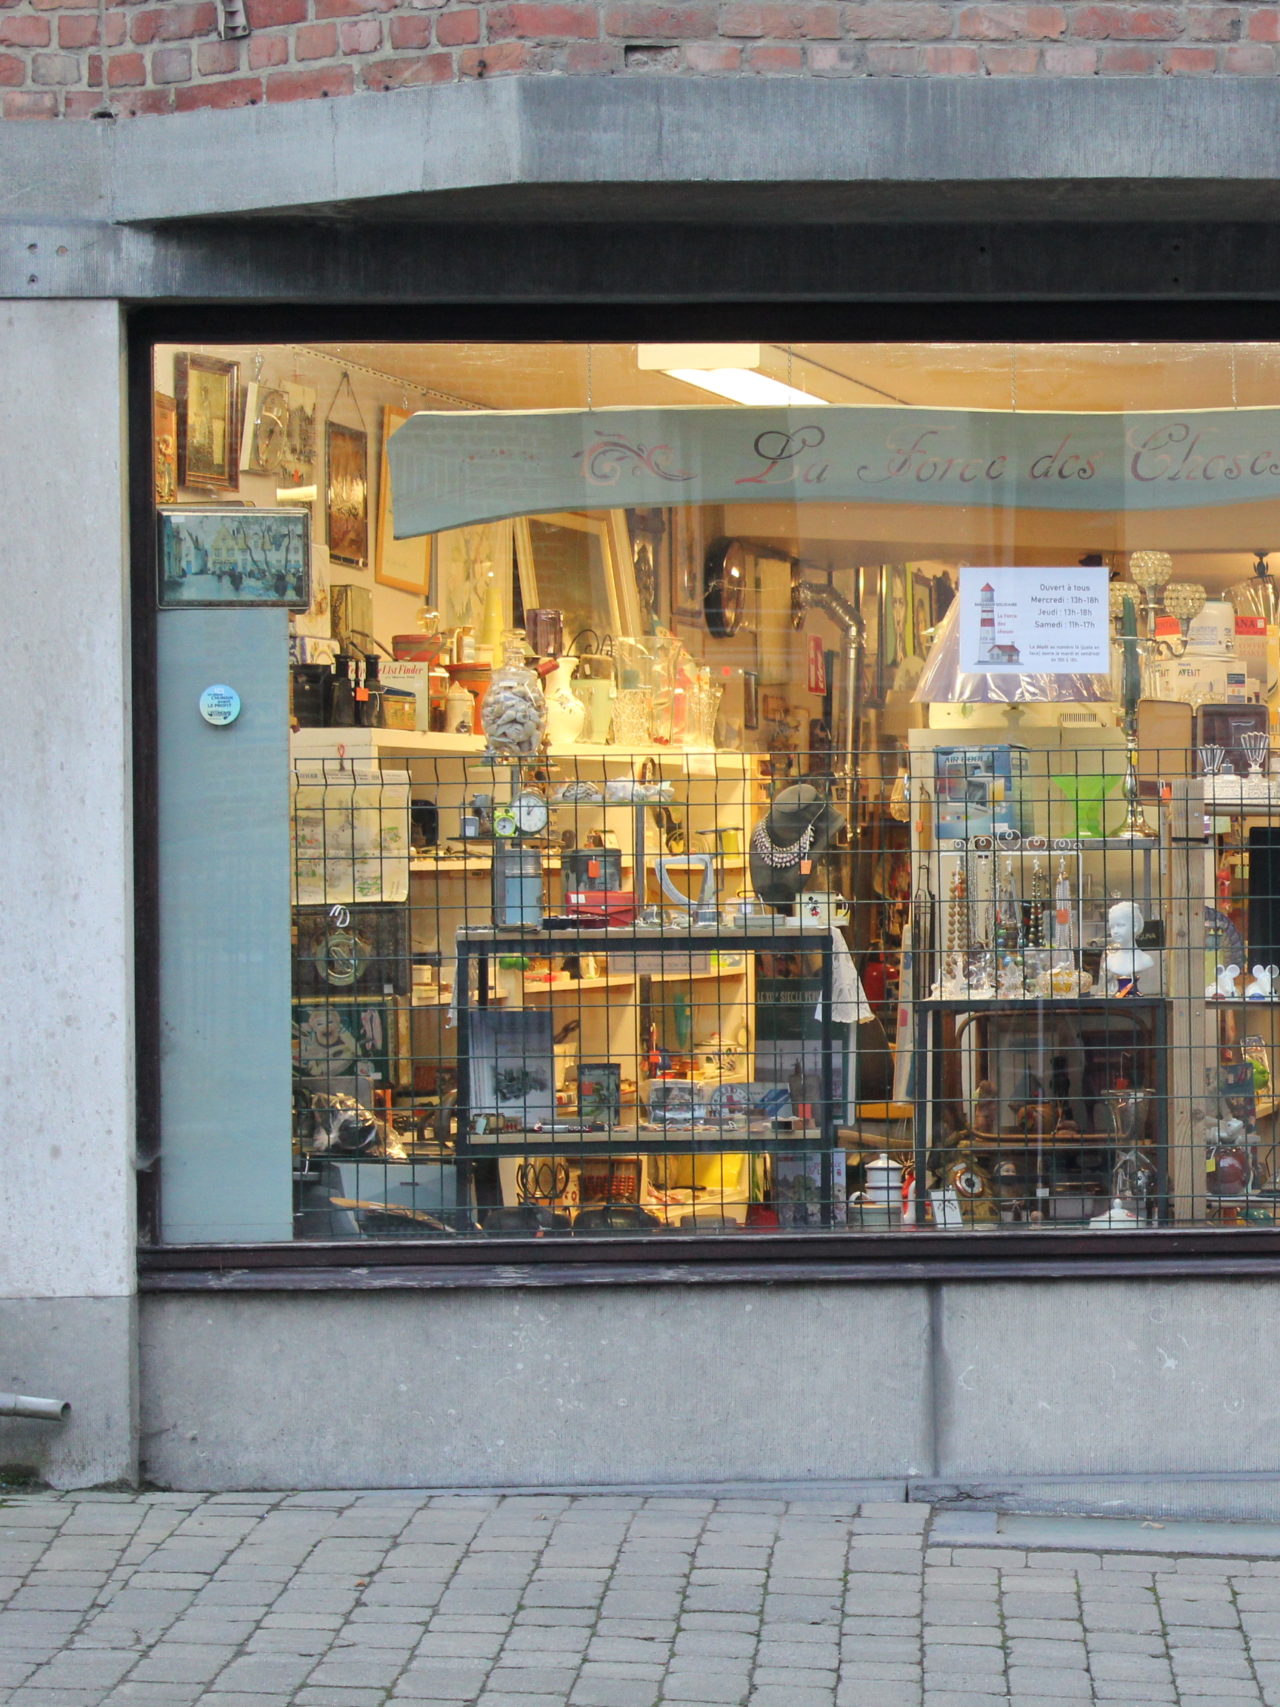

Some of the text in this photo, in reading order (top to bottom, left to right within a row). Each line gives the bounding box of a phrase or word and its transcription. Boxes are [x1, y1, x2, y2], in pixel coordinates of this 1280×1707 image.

[734, 425, 829, 484] La
[1028, 432, 1101, 482] des
[1039, 584, 1065, 592] Ouvert
[1074, 584, 1091, 592] tous
[1031, 596, 1065, 604] Mercredi
[1071, 596, 1100, 604] 13h-18h
[1034, 621, 1063, 629] Samedi
[1069, 621, 1096, 629] 11h-17h
[398, 664, 423, 676] Finder
